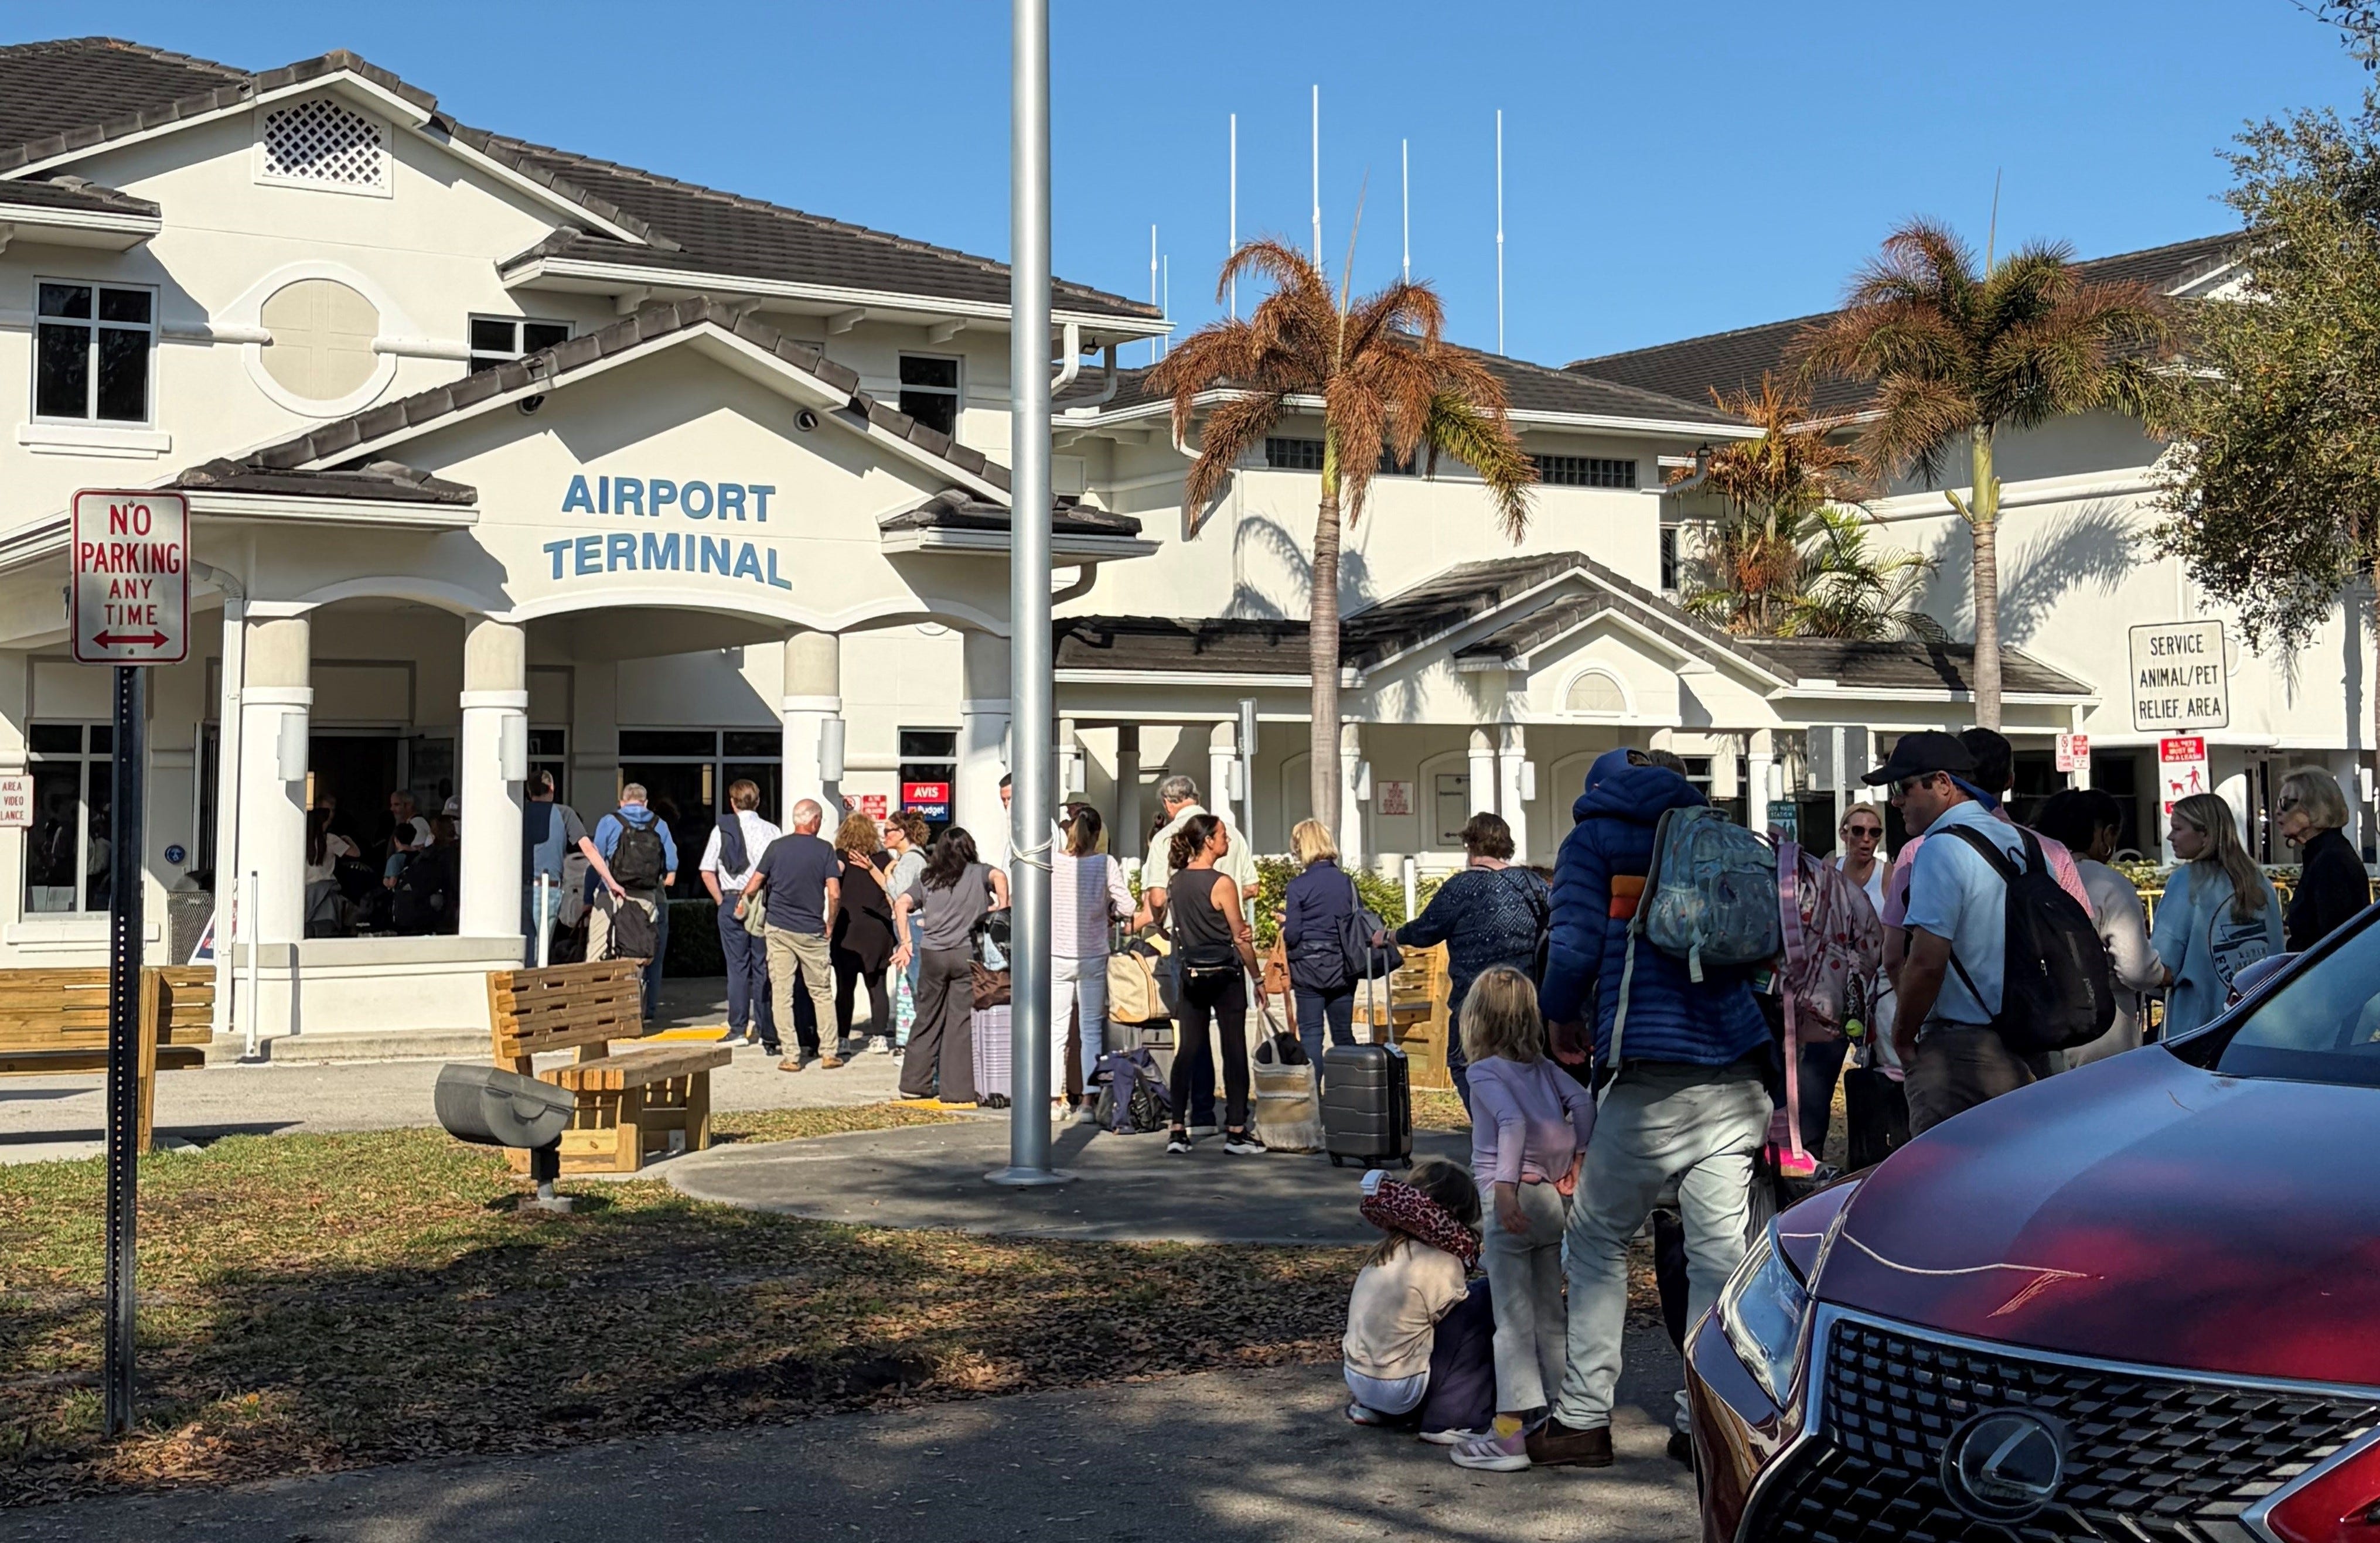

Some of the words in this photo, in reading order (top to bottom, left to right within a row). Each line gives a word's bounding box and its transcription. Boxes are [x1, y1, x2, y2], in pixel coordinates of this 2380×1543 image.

[561, 474, 776, 522] AIRPORT
[110, 504, 151, 535] NO
[81, 542, 180, 574] PARKING
[543, 532, 793, 590] TERMINAL
[109, 579, 153, 599] ANY
[104, 605, 158, 625] TIME
[2150, 634, 2204, 656] SERVICE
[2140, 665, 2218, 688] ANIMAL/PET
[2139, 699, 2178, 719] RELIEF
[2187, 697, 2221, 717] AREA
[2, 781, 22, 791] AREA
[913, 787, 939, 798] AVIS
[4, 796, 23, 805] VIDEO
